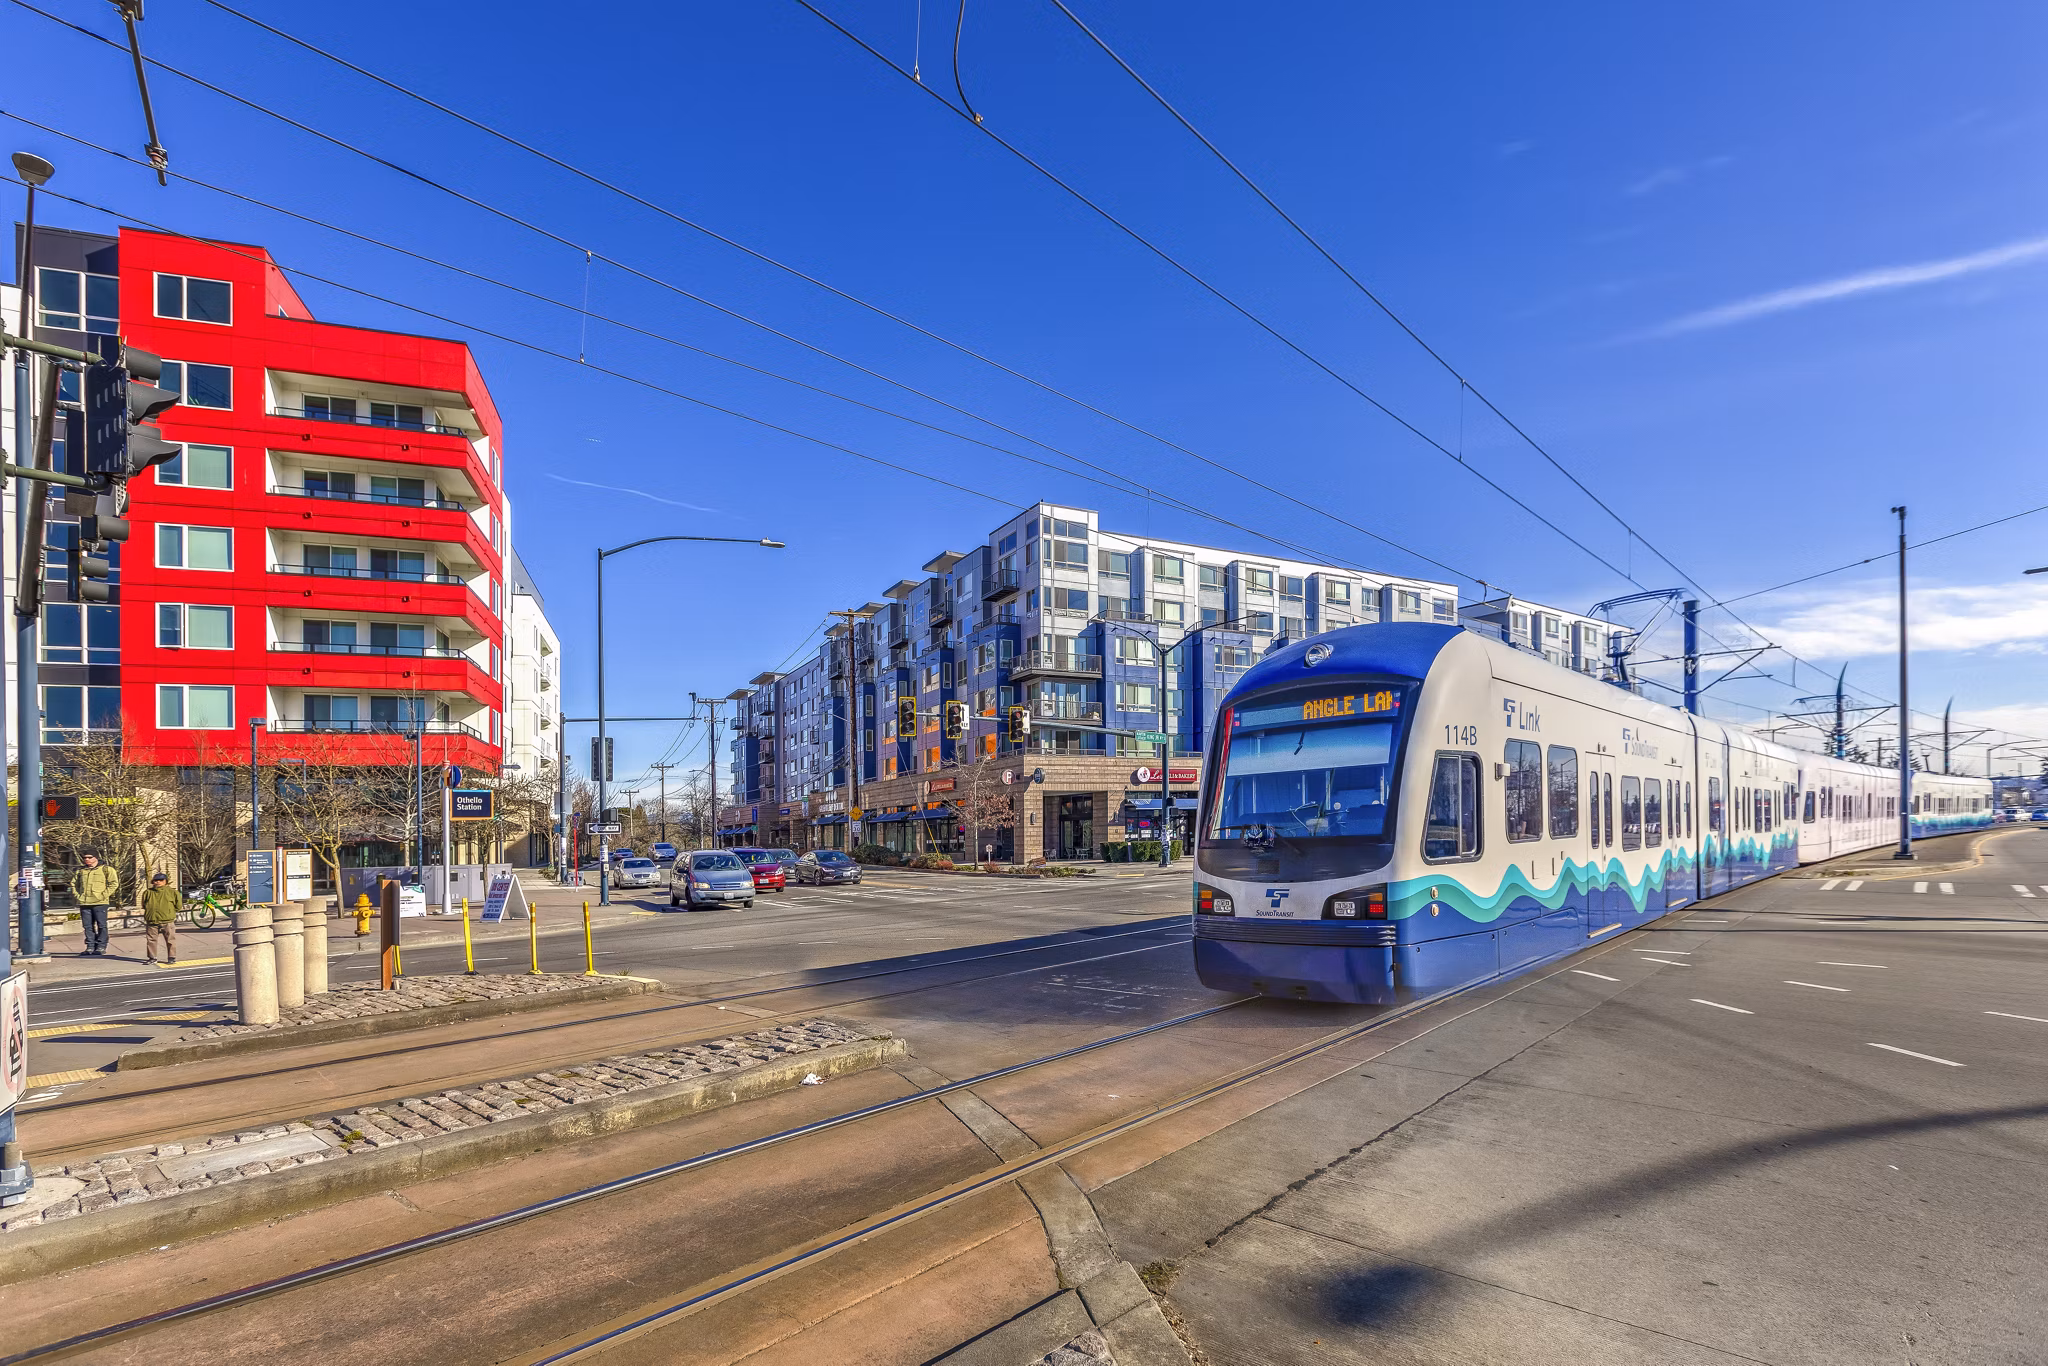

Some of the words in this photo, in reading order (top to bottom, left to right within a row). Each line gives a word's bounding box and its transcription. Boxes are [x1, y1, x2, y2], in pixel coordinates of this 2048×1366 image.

[1303, 695, 1354, 720] ANGLE
[1520, 702, 1540, 732] Link
[1445, 724, 1477, 746] 114B
[456, 796, 483, 804] Othello
[456, 803, 482, 811] Station
